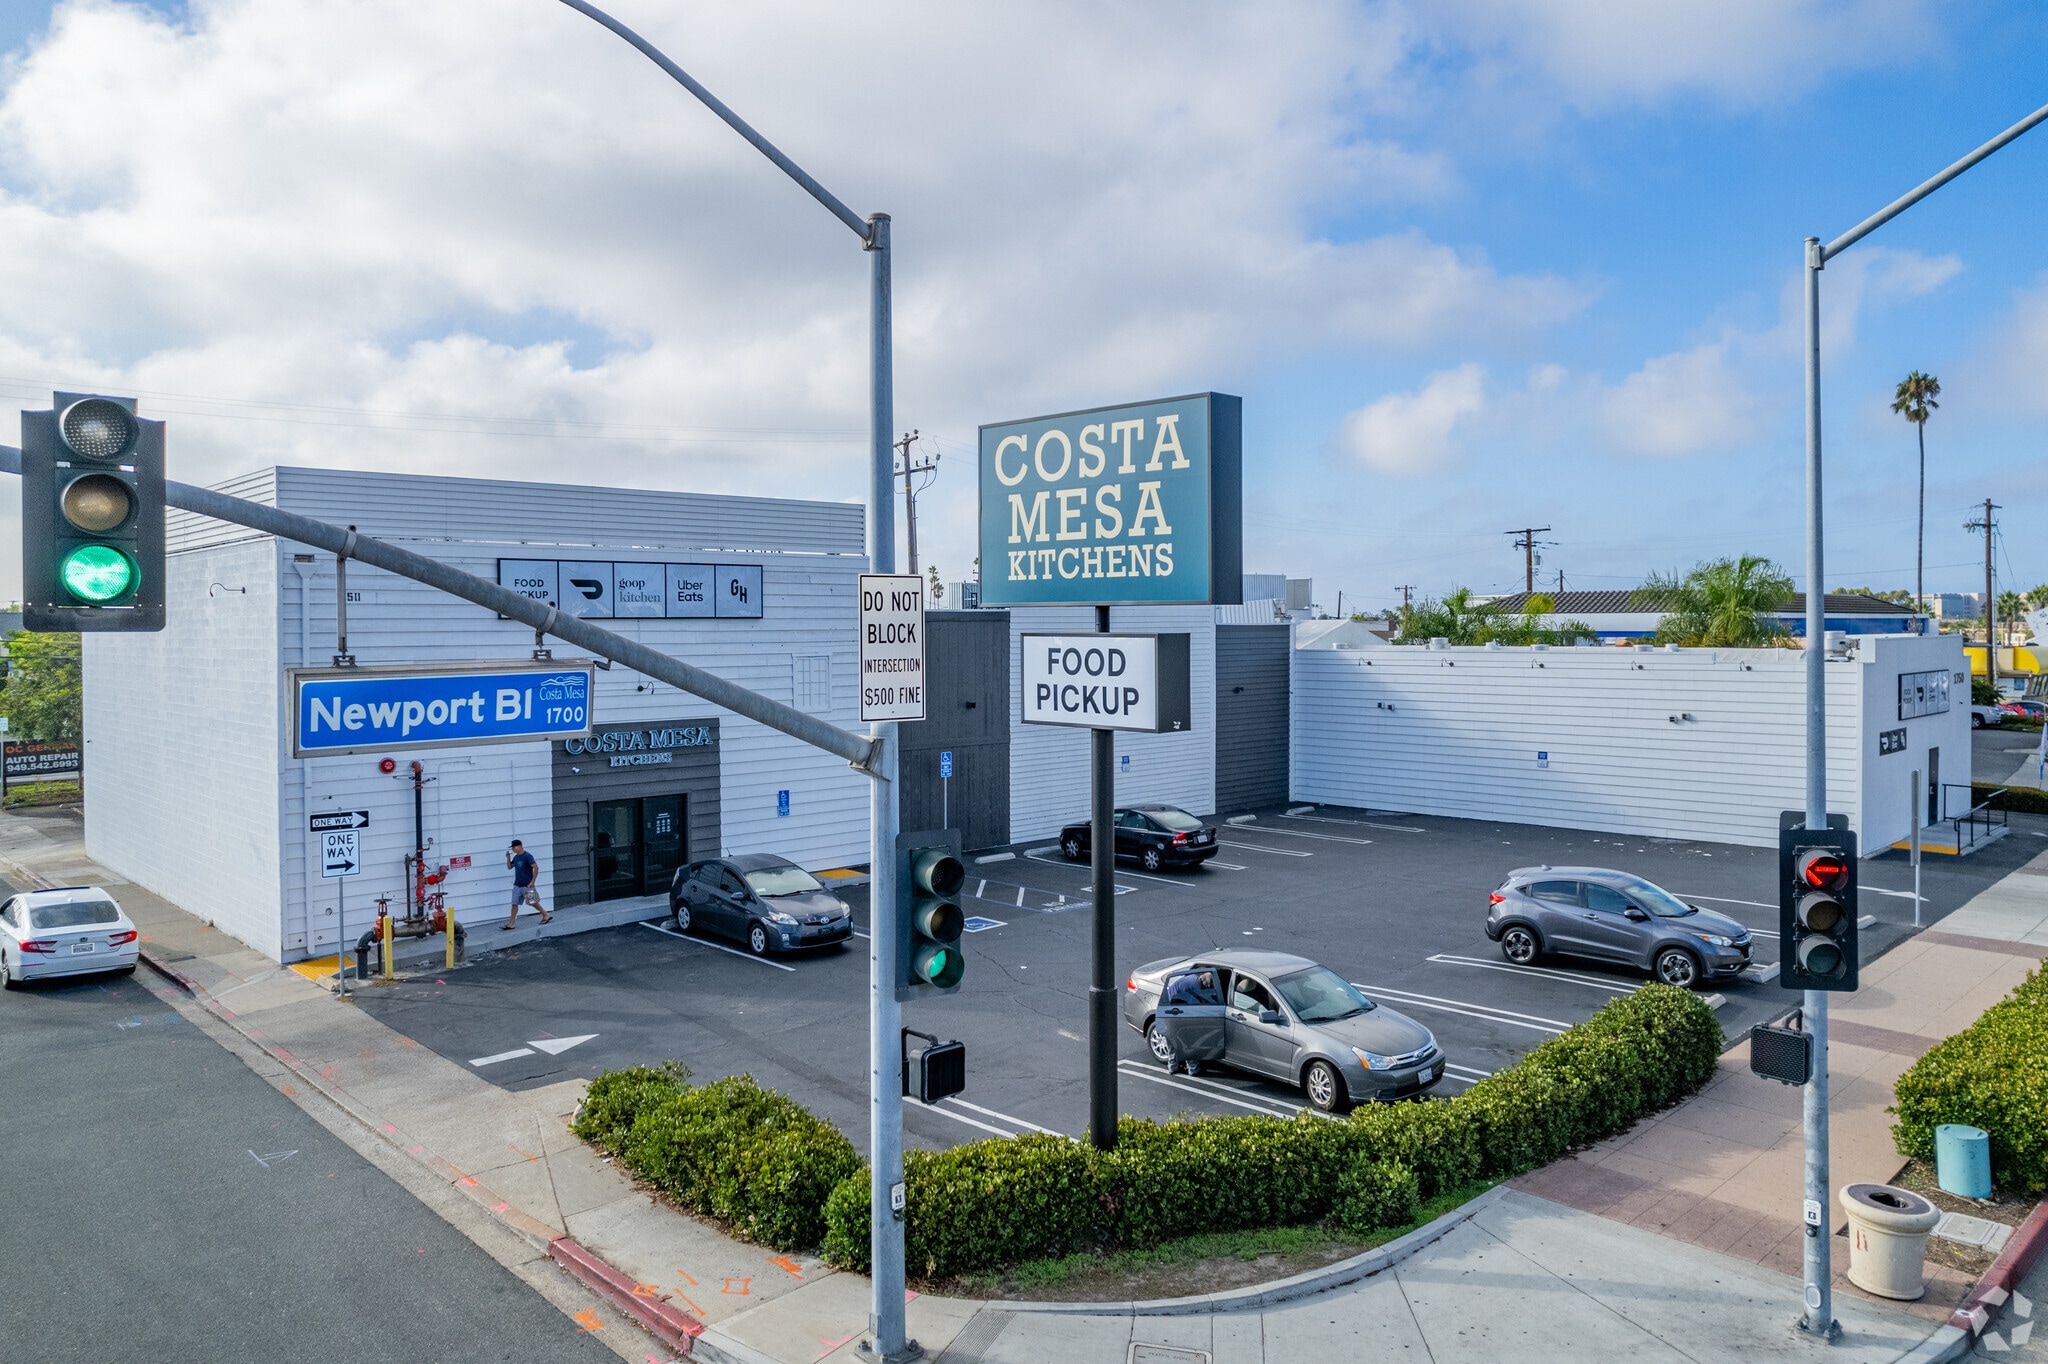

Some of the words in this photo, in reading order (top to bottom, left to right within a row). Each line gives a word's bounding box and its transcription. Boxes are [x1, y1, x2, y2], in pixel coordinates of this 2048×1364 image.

[994, 414, 1190, 487] COSTA
[1007, 480, 1172, 544] MESA
[1007, 542, 1174, 581] KITCHENS
[514, 578, 544, 587] FOOD
[618, 578, 646, 590] goop
[677, 579, 703, 591] Uber
[513, 590, 549, 599] CKUP
[619, 591, 661, 603] kitchen
[677, 591, 704, 602] Eats
[863, 590, 884, 612] DO
[891, 590, 919, 612] NOT
[867, 623, 917, 644] BLOCK
[864, 658, 921, 674] INTERSECTION
[1047, 647, 1126, 677] FOOD
[539, 686, 562, 701] Costa
[564, 685, 585, 700] Mesa
[864, 687, 894, 708] $500
[899, 686, 921, 704] FINE
[1036, 683, 1140, 716] PICKUP
[309, 689, 485, 737] Newport
[495, 687, 533, 722] Bl
[546, 705, 584, 724] 1700
[565, 730, 647, 755] COSTA
[649, 726, 714, 749] MESA
[6, 745, 23, 754] OC
[5, 755, 37, 765] AUTO
[40, 752, 79, 762] REPAIR
[7, 760, 78, 772] 949.542.6993
[609, 751, 673, 768] KITCHENS
[314, 819, 332, 827] ONE
[334, 816, 353, 825] WAY
[328, 833, 354, 846] ONE
[326, 846, 355, 859] WAY
